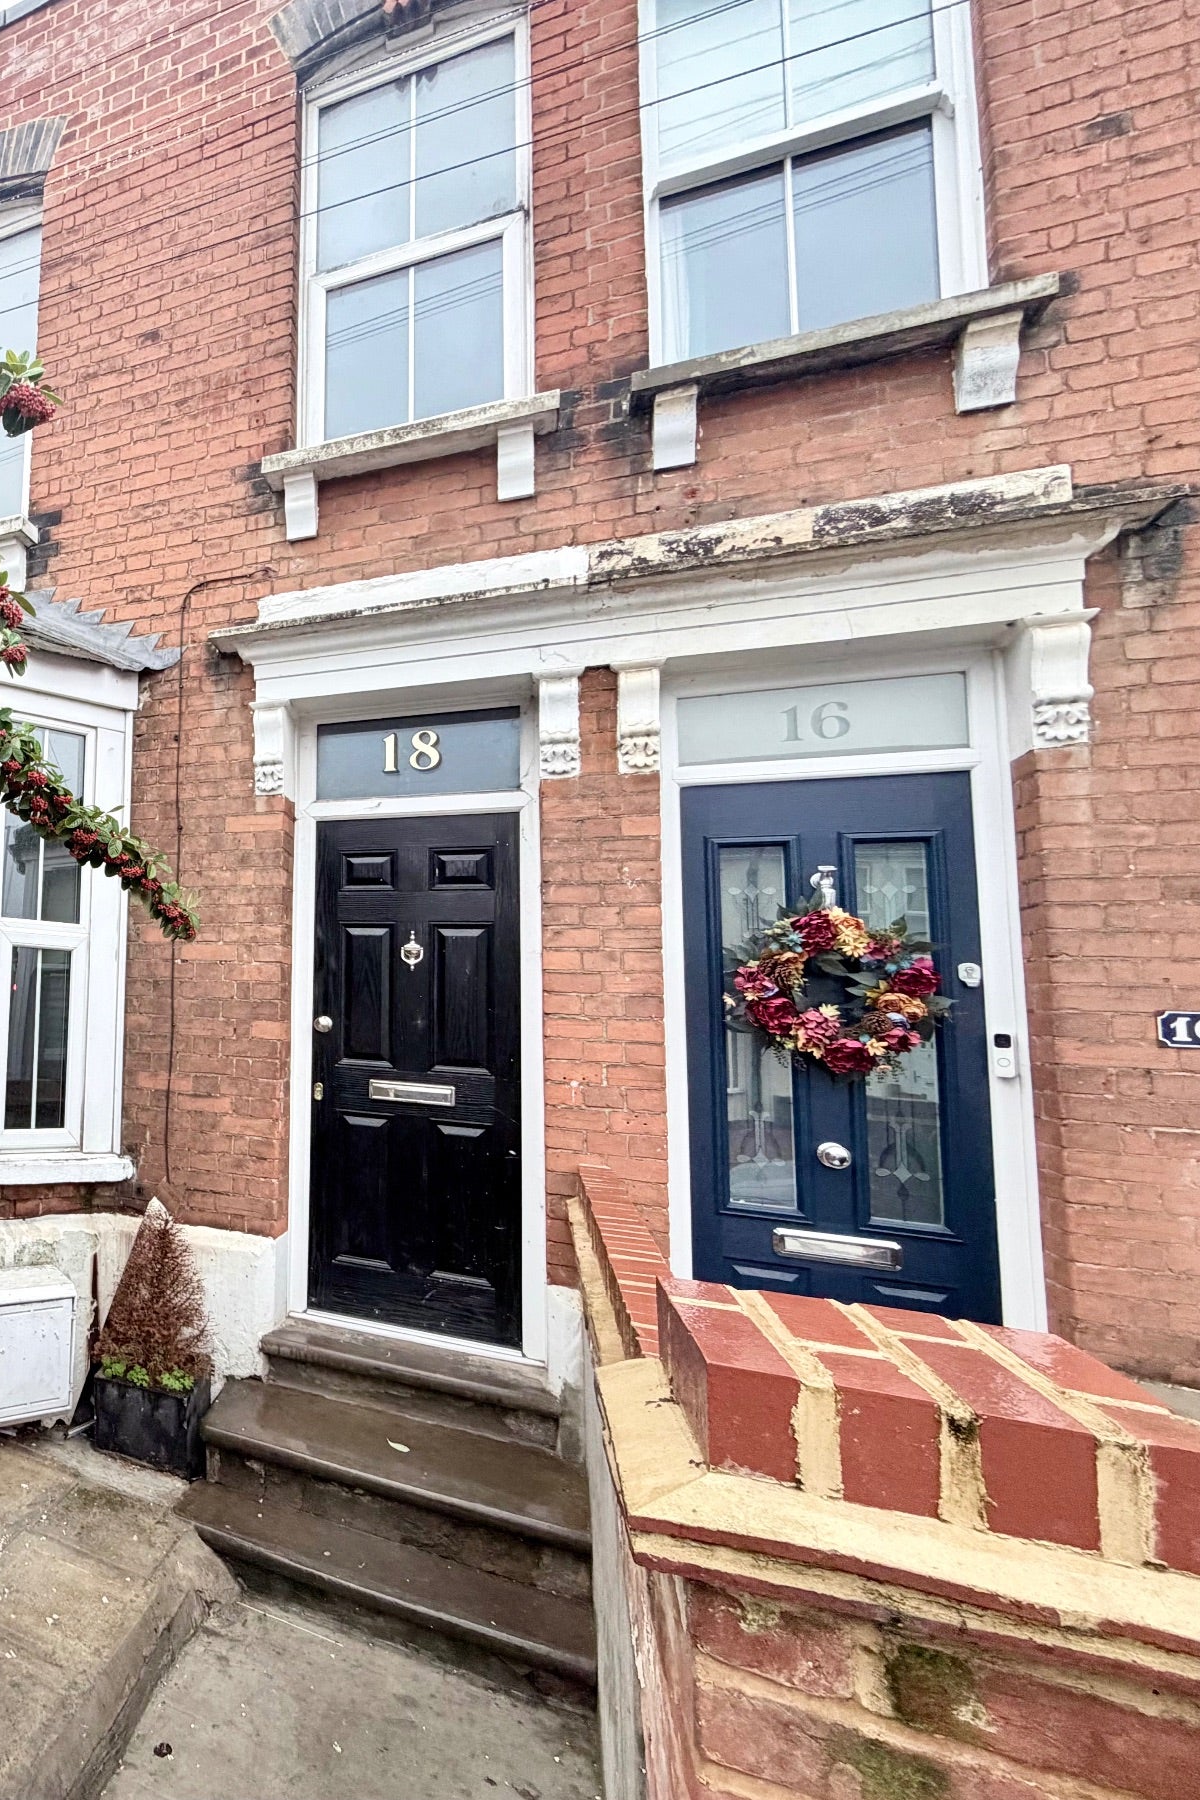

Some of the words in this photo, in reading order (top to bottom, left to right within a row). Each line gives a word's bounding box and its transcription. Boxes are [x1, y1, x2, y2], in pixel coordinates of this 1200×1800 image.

[780, 701, 850, 742] 16
[382, 730, 441, 773] 18
[1170, 1017, 1200, 1041] 1
